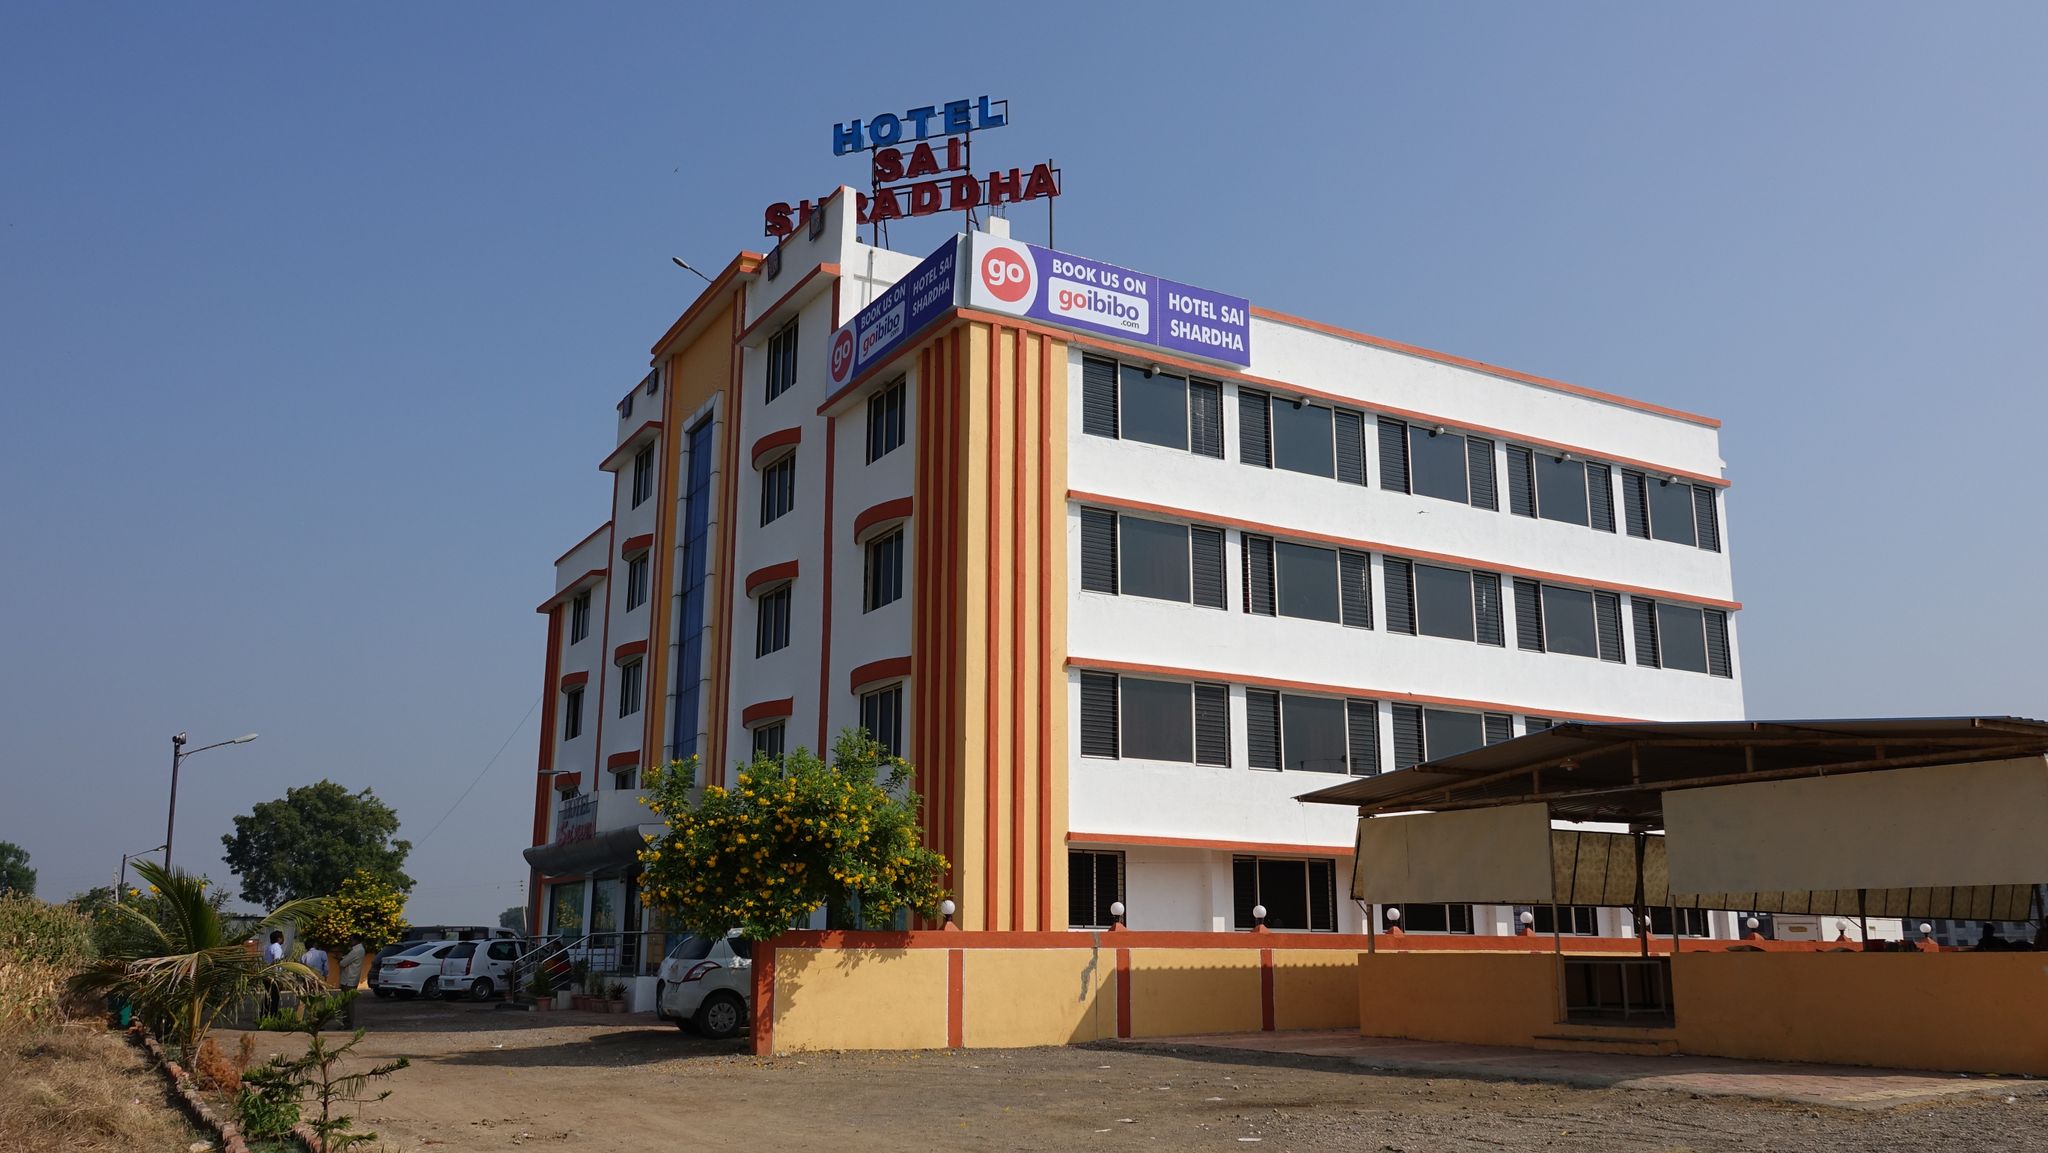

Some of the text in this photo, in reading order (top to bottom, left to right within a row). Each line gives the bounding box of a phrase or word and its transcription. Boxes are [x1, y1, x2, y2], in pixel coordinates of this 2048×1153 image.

[833, 95, 1005, 156] HOTEL
[875, 137, 961, 182] SAI
[913, 254, 953, 296] HOTEL SAI
[988, 258, 1024, 286] go
[1053, 258, 1146, 295] BOOK US ON
[861, 283, 906, 329] BOOK US ON
[912, 278, 950, 316] SHARDHA
[1058, 289, 1140, 321] goibibo
[1168, 293, 1244, 327] HOTEL SAI
[863, 313, 900, 358] goibibo
[1170, 319, 1244, 351] SHARDHA
[834, 339, 850, 372] go
